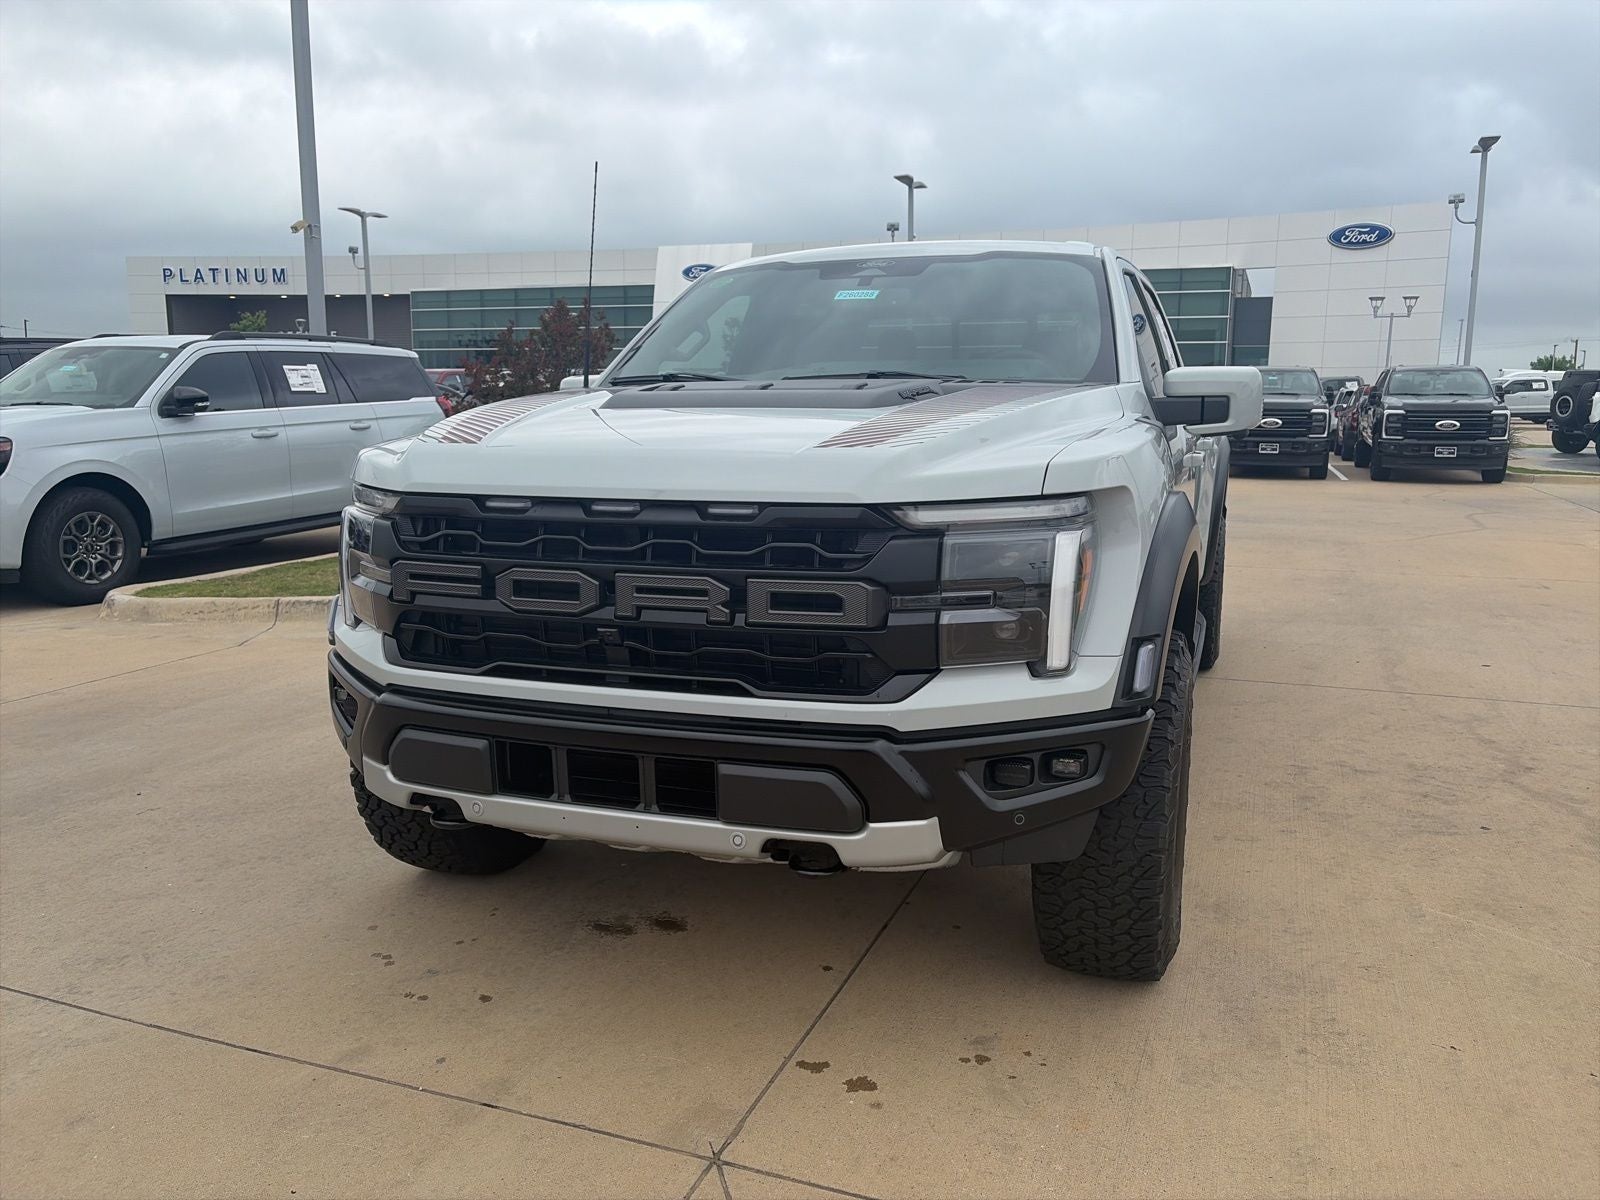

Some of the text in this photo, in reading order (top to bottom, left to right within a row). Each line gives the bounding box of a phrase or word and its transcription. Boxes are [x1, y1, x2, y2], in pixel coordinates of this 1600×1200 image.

[1341, 227, 1380, 243] Ford
[162, 267, 288, 285] PLATINUM
[392, 560, 885, 629] FORD
